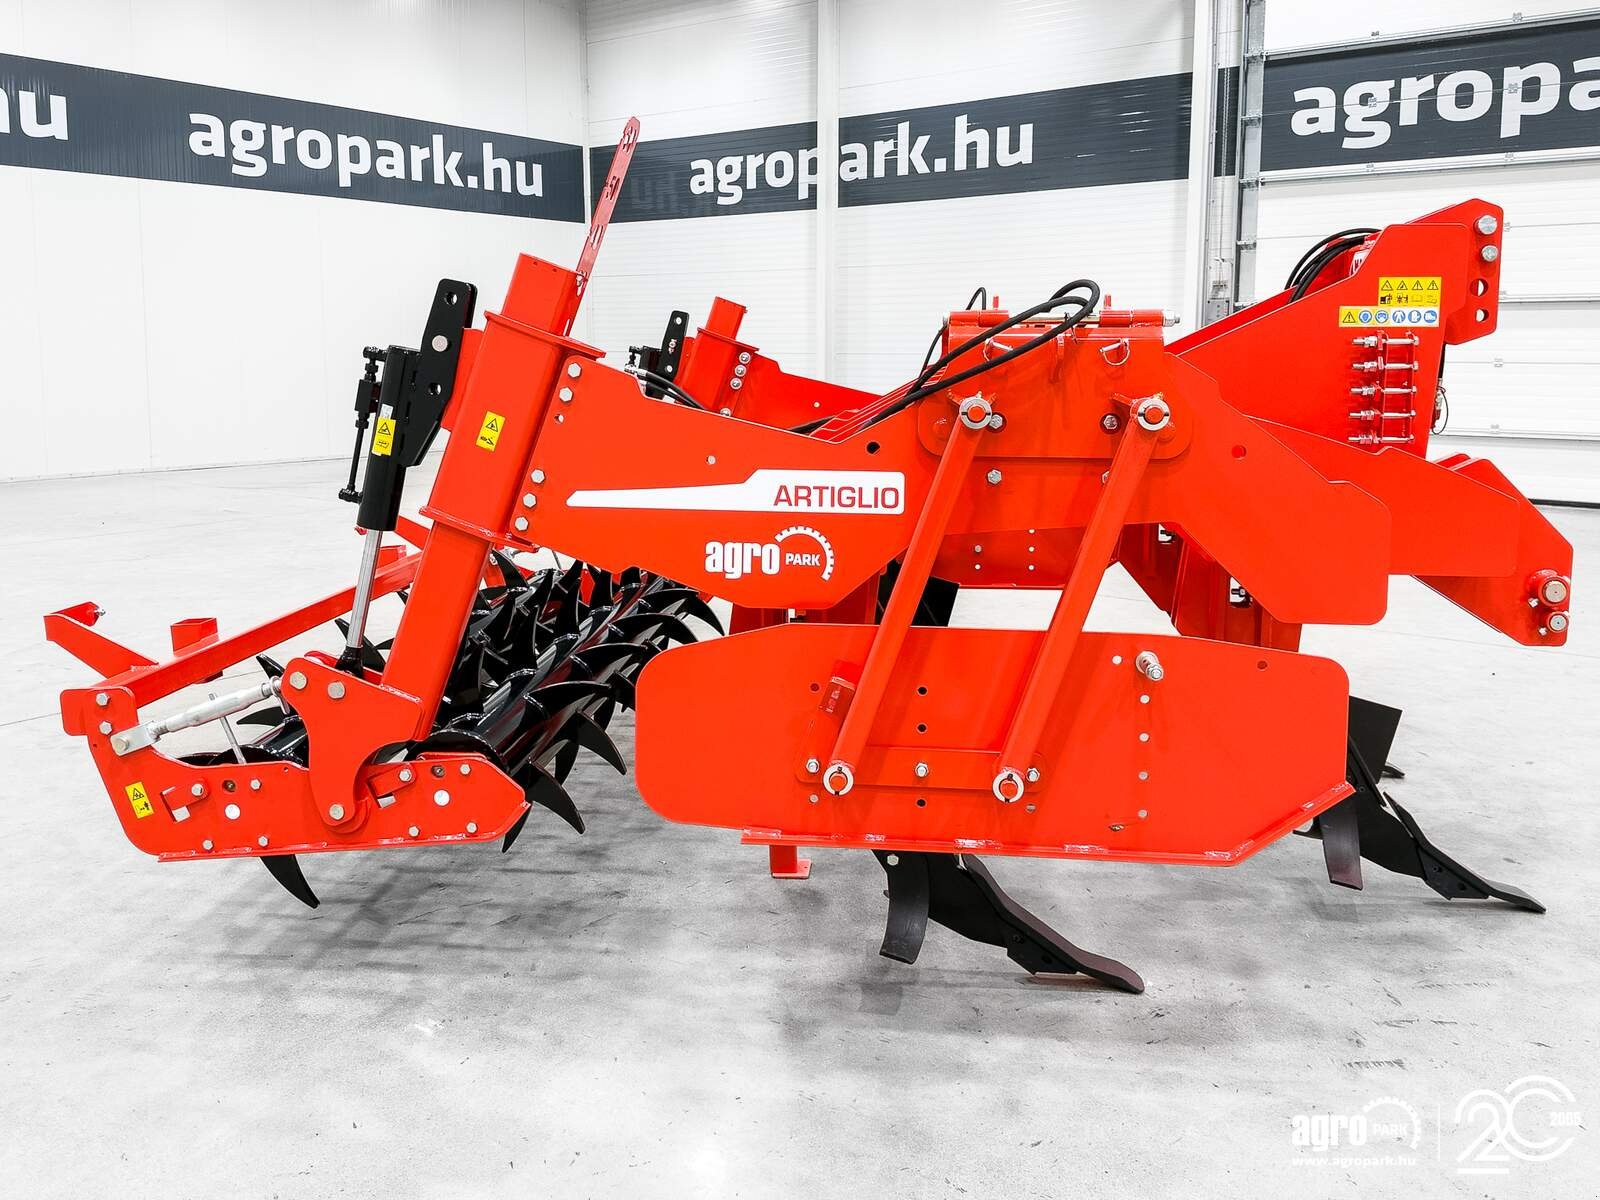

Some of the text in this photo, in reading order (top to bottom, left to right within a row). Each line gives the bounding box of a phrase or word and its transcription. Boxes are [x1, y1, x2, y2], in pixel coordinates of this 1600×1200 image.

[0, 87, 68, 140] u
[188, 113, 543, 197] agropark.hu
[773, 485, 900, 509] ARTIGLIO
[705, 541, 821, 580] agro PARK
